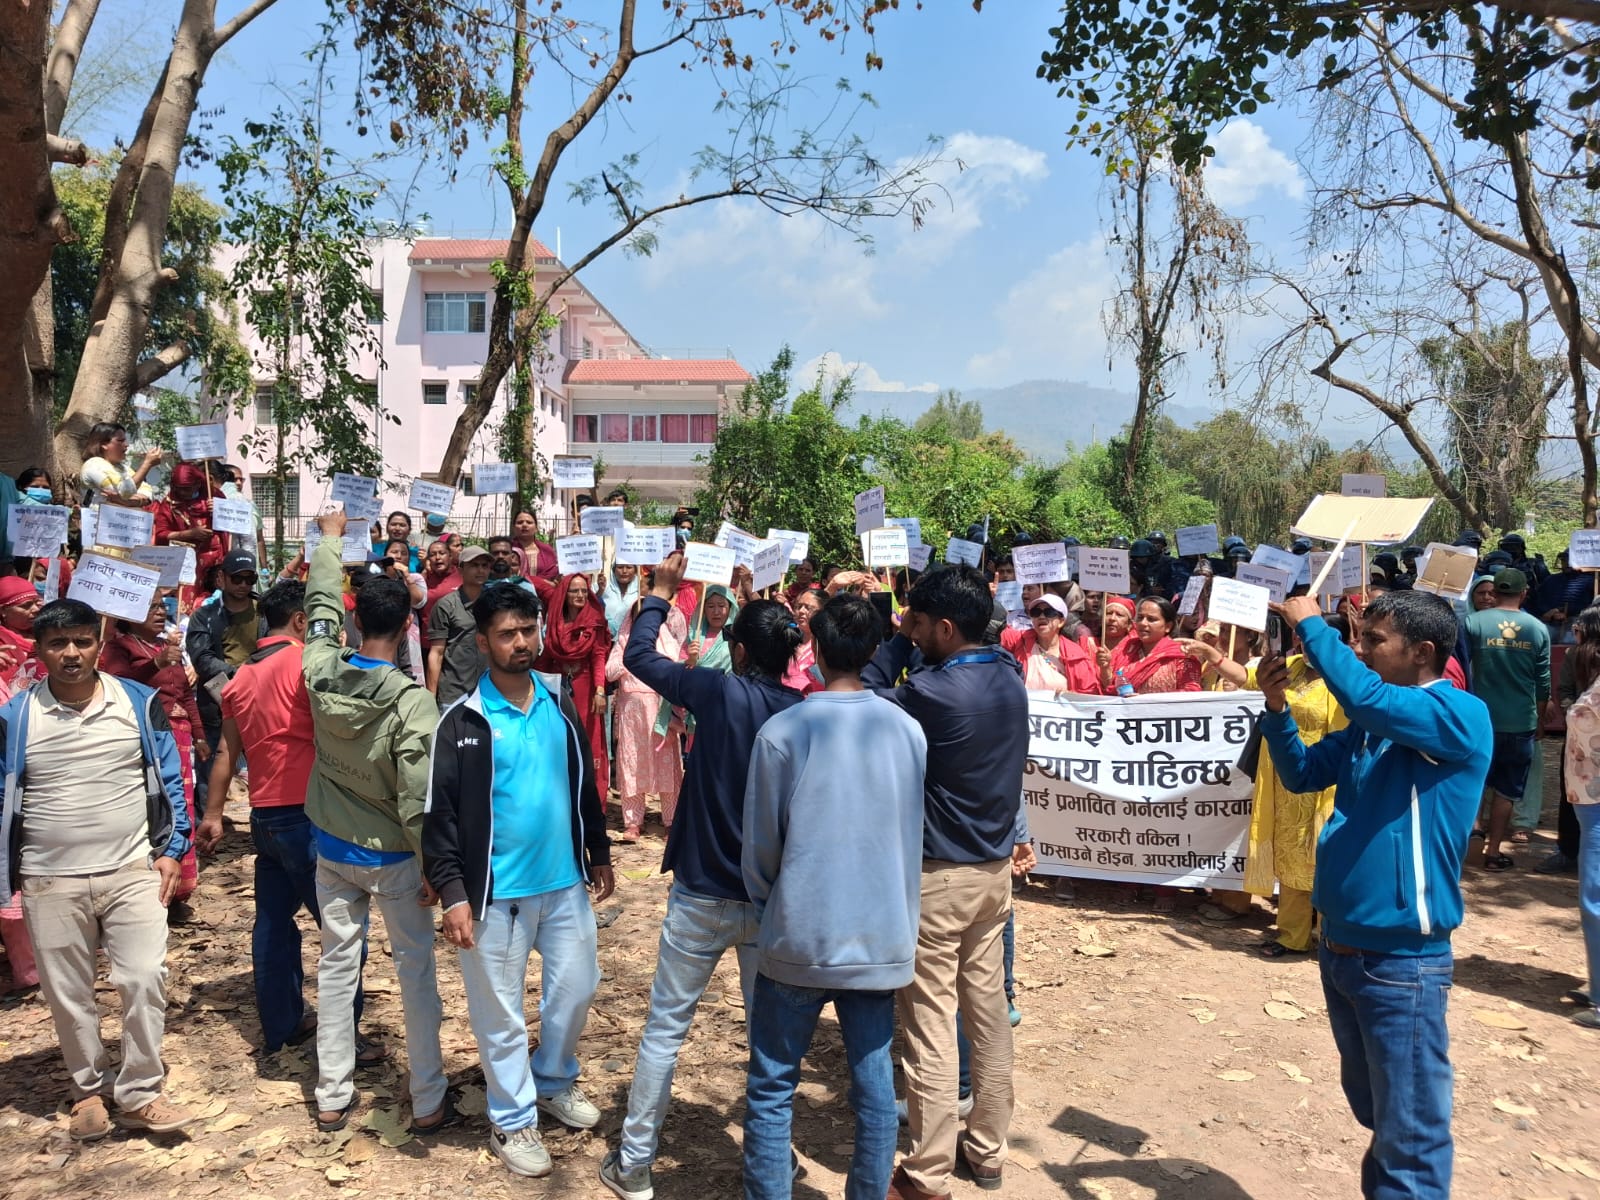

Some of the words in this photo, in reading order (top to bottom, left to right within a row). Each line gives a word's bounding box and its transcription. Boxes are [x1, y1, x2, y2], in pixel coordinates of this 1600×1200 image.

[1486, 637, 1532, 650] KELME
[1029, 710, 1106, 747] षलाई
[1117, 716, 1213, 745] सजाय
[1223, 706, 1260, 744] हो
[1111, 750, 1233, 789] चाहिन्छ
[1055, 792, 1117, 816] प्रभावित
[1123, 796, 1188, 820] गर्नेलाई
[1075, 827, 1131, 846] सरकारी
[1136, 828, 1180, 847] वकिल
[1040, 842, 1092, 862] फसाउने
[1142, 850, 1226, 873] अपराधीलाई
[1232, 856, 1248, 873] स
